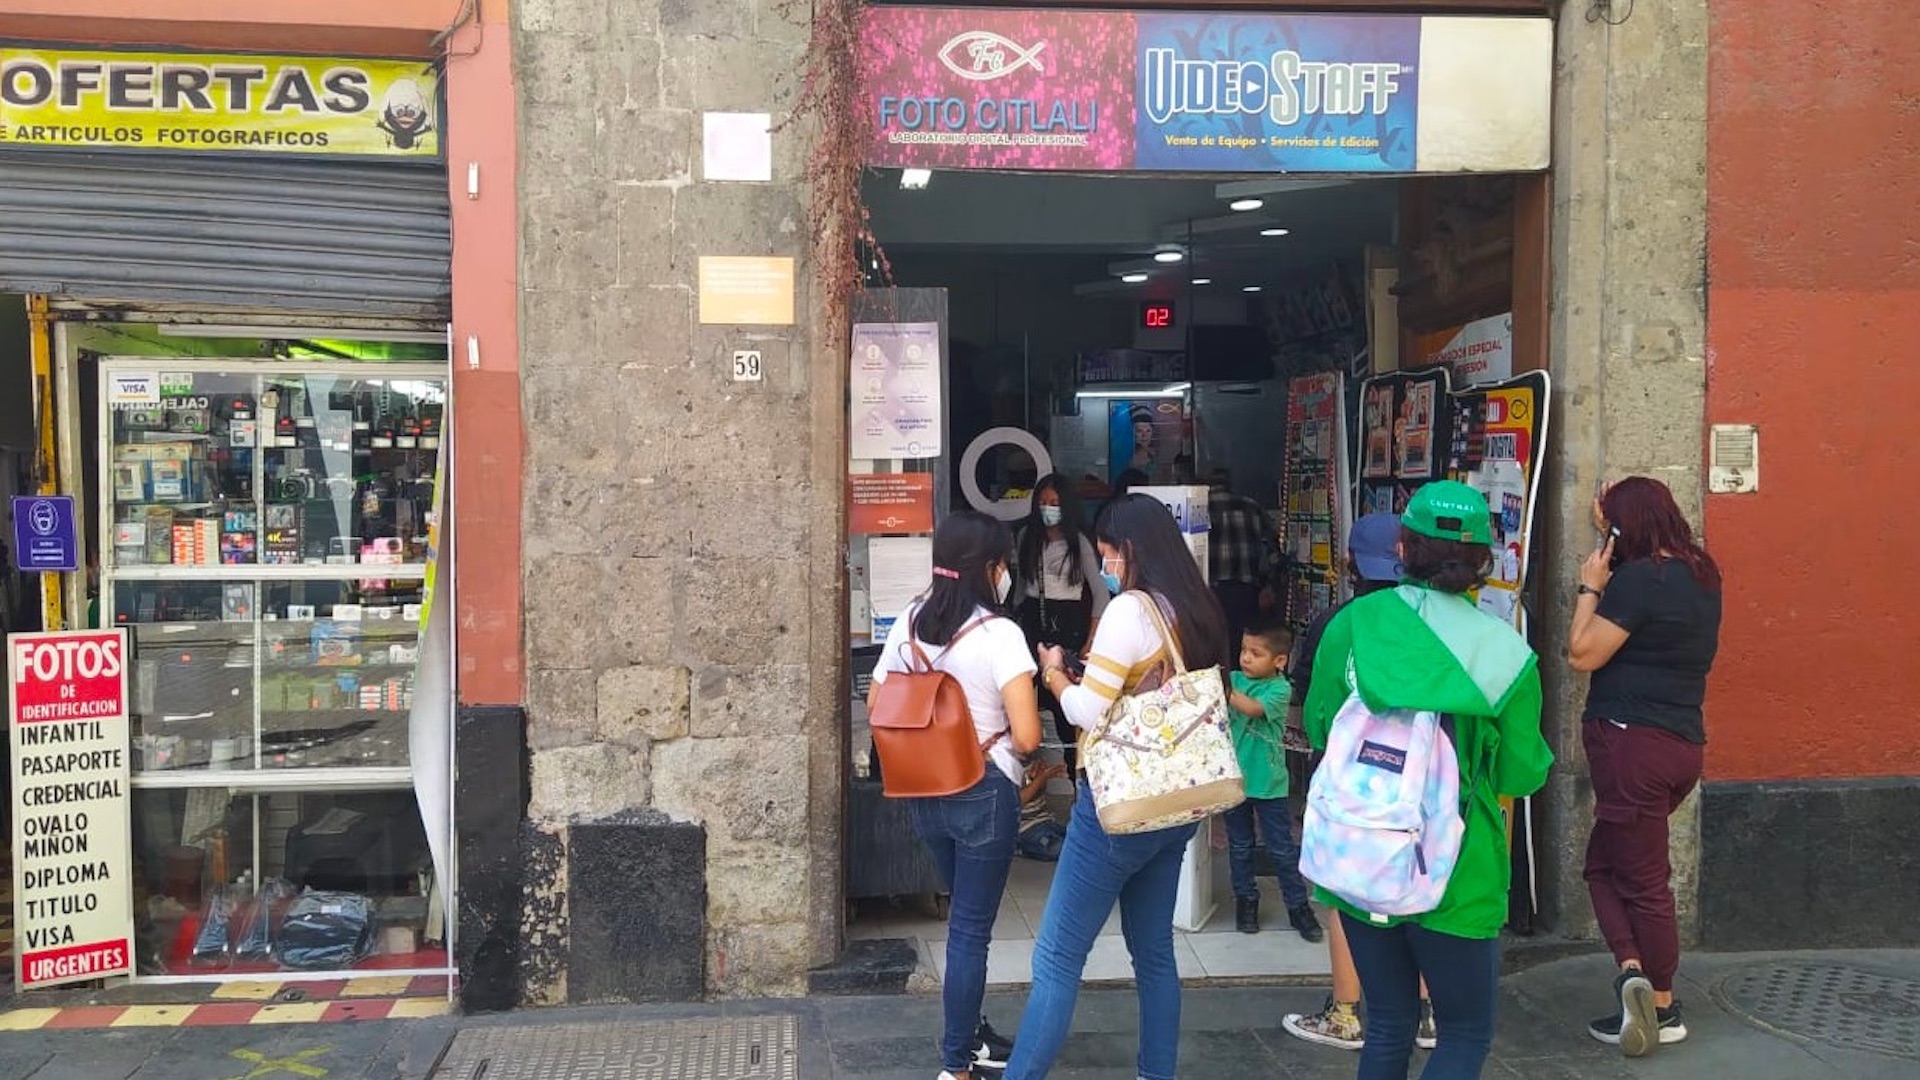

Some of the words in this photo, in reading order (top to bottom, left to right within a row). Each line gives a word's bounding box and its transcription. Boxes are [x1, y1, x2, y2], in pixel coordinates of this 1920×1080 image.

[1, 62, 371, 115] OFERTAS
[879, 96, 967, 131] FOTO
[976, 98, 1098, 133] CITLALI
[15, 124, 144, 143] ARTICULOS
[157, 128, 329, 147] FOTOGRAFICOS
[888, 132, 967, 144] LABORATORIO
[968, 133, 1011, 145] DIGITAL
[1012, 134, 1088, 146] PROFESIONAL
[1165, 135, 1197, 146] Venta
[1201, 135, 1214, 146] de
[1217, 136, 1257, 149] Equipo
[1270, 136, 1319, 147] Servicios
[1322, 135, 1337, 147] de
[1340, 135, 1379, 147] Edición
[1146, 308, 1169, 326] 02
[734, 354, 760, 376] 59
[121, 383, 147, 394] VISA
[15, 639, 121, 684] FOTOS
[60, 684, 76, 699] DE
[22, 700, 118, 720] IDENTIFICACION
[20, 721, 105, 746] INFANTIL
[21, 749, 122, 777] PASAPORTE
[22, 778, 123, 808] CREDENCIAL
[24, 812, 89, 837] OVALO
[24, 831, 89, 860] MIÑON
[24, 861, 110, 890] DIPLOMA
[26, 892, 98, 920] TITULO
[26, 924, 75, 949] VISA
[29, 946, 125, 981] URGENTES
